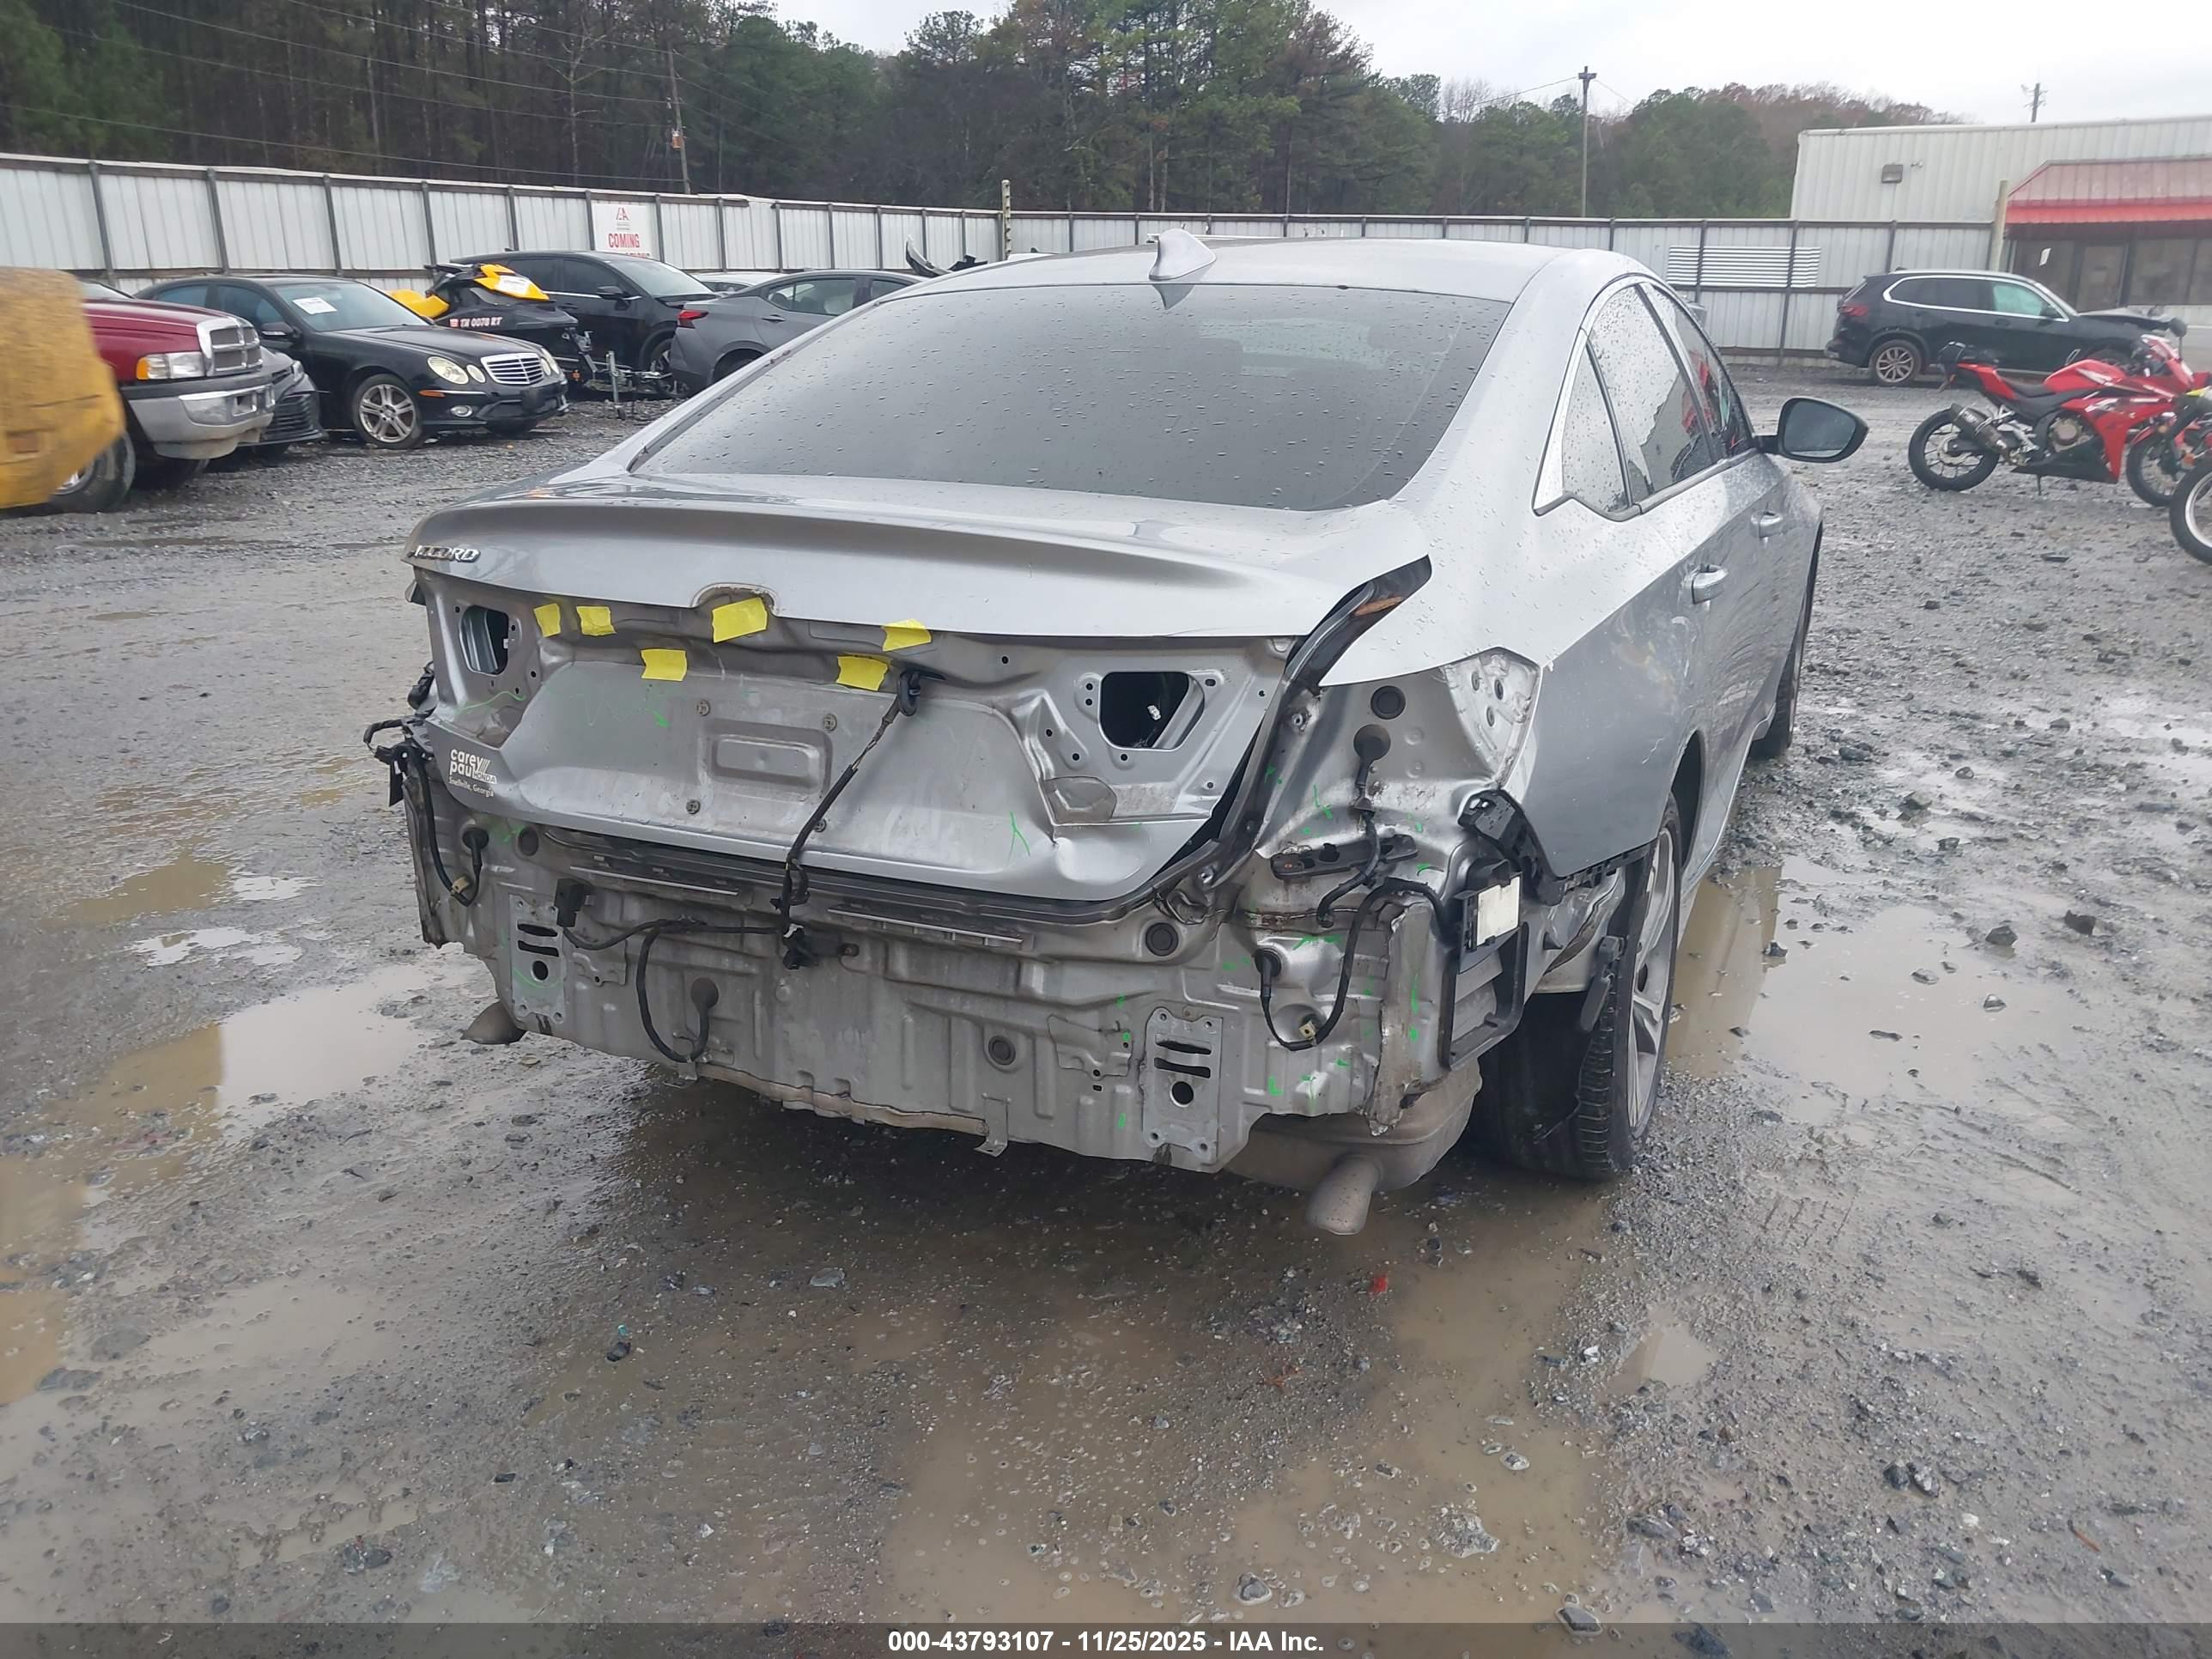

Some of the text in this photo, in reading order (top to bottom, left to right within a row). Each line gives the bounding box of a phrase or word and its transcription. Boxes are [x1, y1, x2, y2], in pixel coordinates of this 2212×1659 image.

[608, 233, 641, 248] COMING
[449, 760, 475, 779] paul
[450, 749, 483, 773] carey
[473, 772, 496, 784] HONDA
